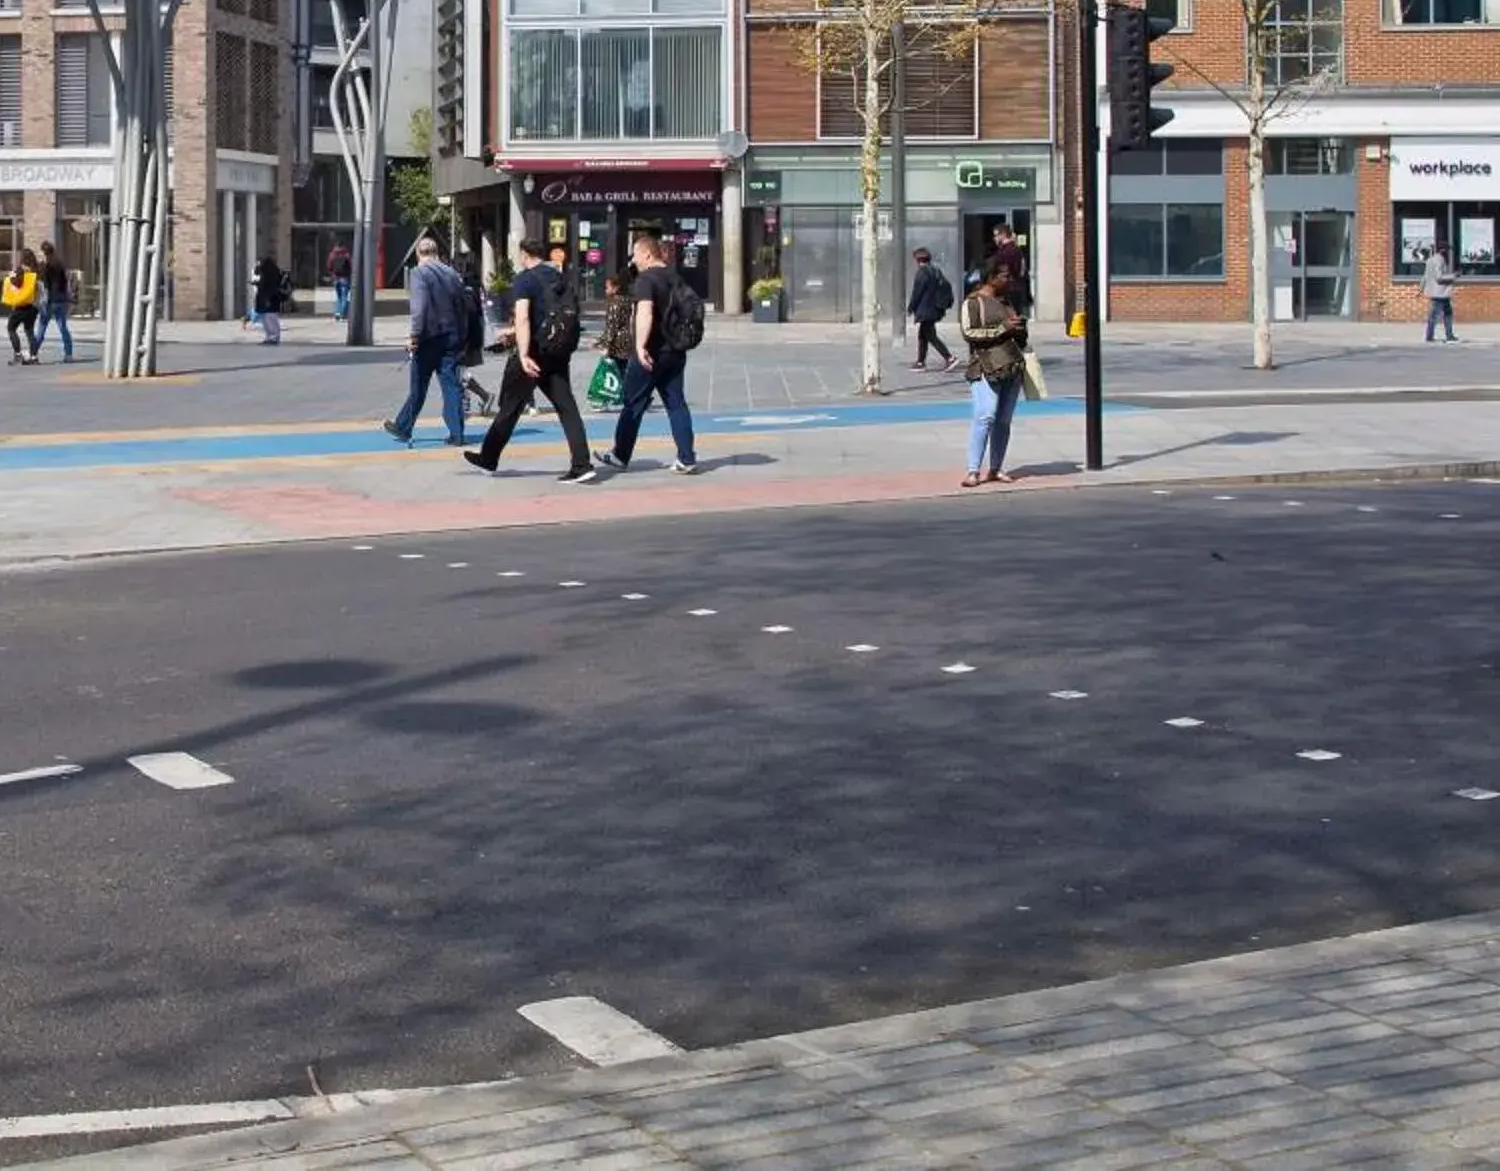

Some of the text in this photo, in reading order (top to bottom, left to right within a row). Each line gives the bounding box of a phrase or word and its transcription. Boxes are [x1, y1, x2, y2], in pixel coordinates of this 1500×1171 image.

[1, 165, 96, 183] BROADWAY
[1409, 160, 1492, 178] workplace
[605, 191, 638, 202] GRILL
[643, 191, 714, 202] RESTAURANT
